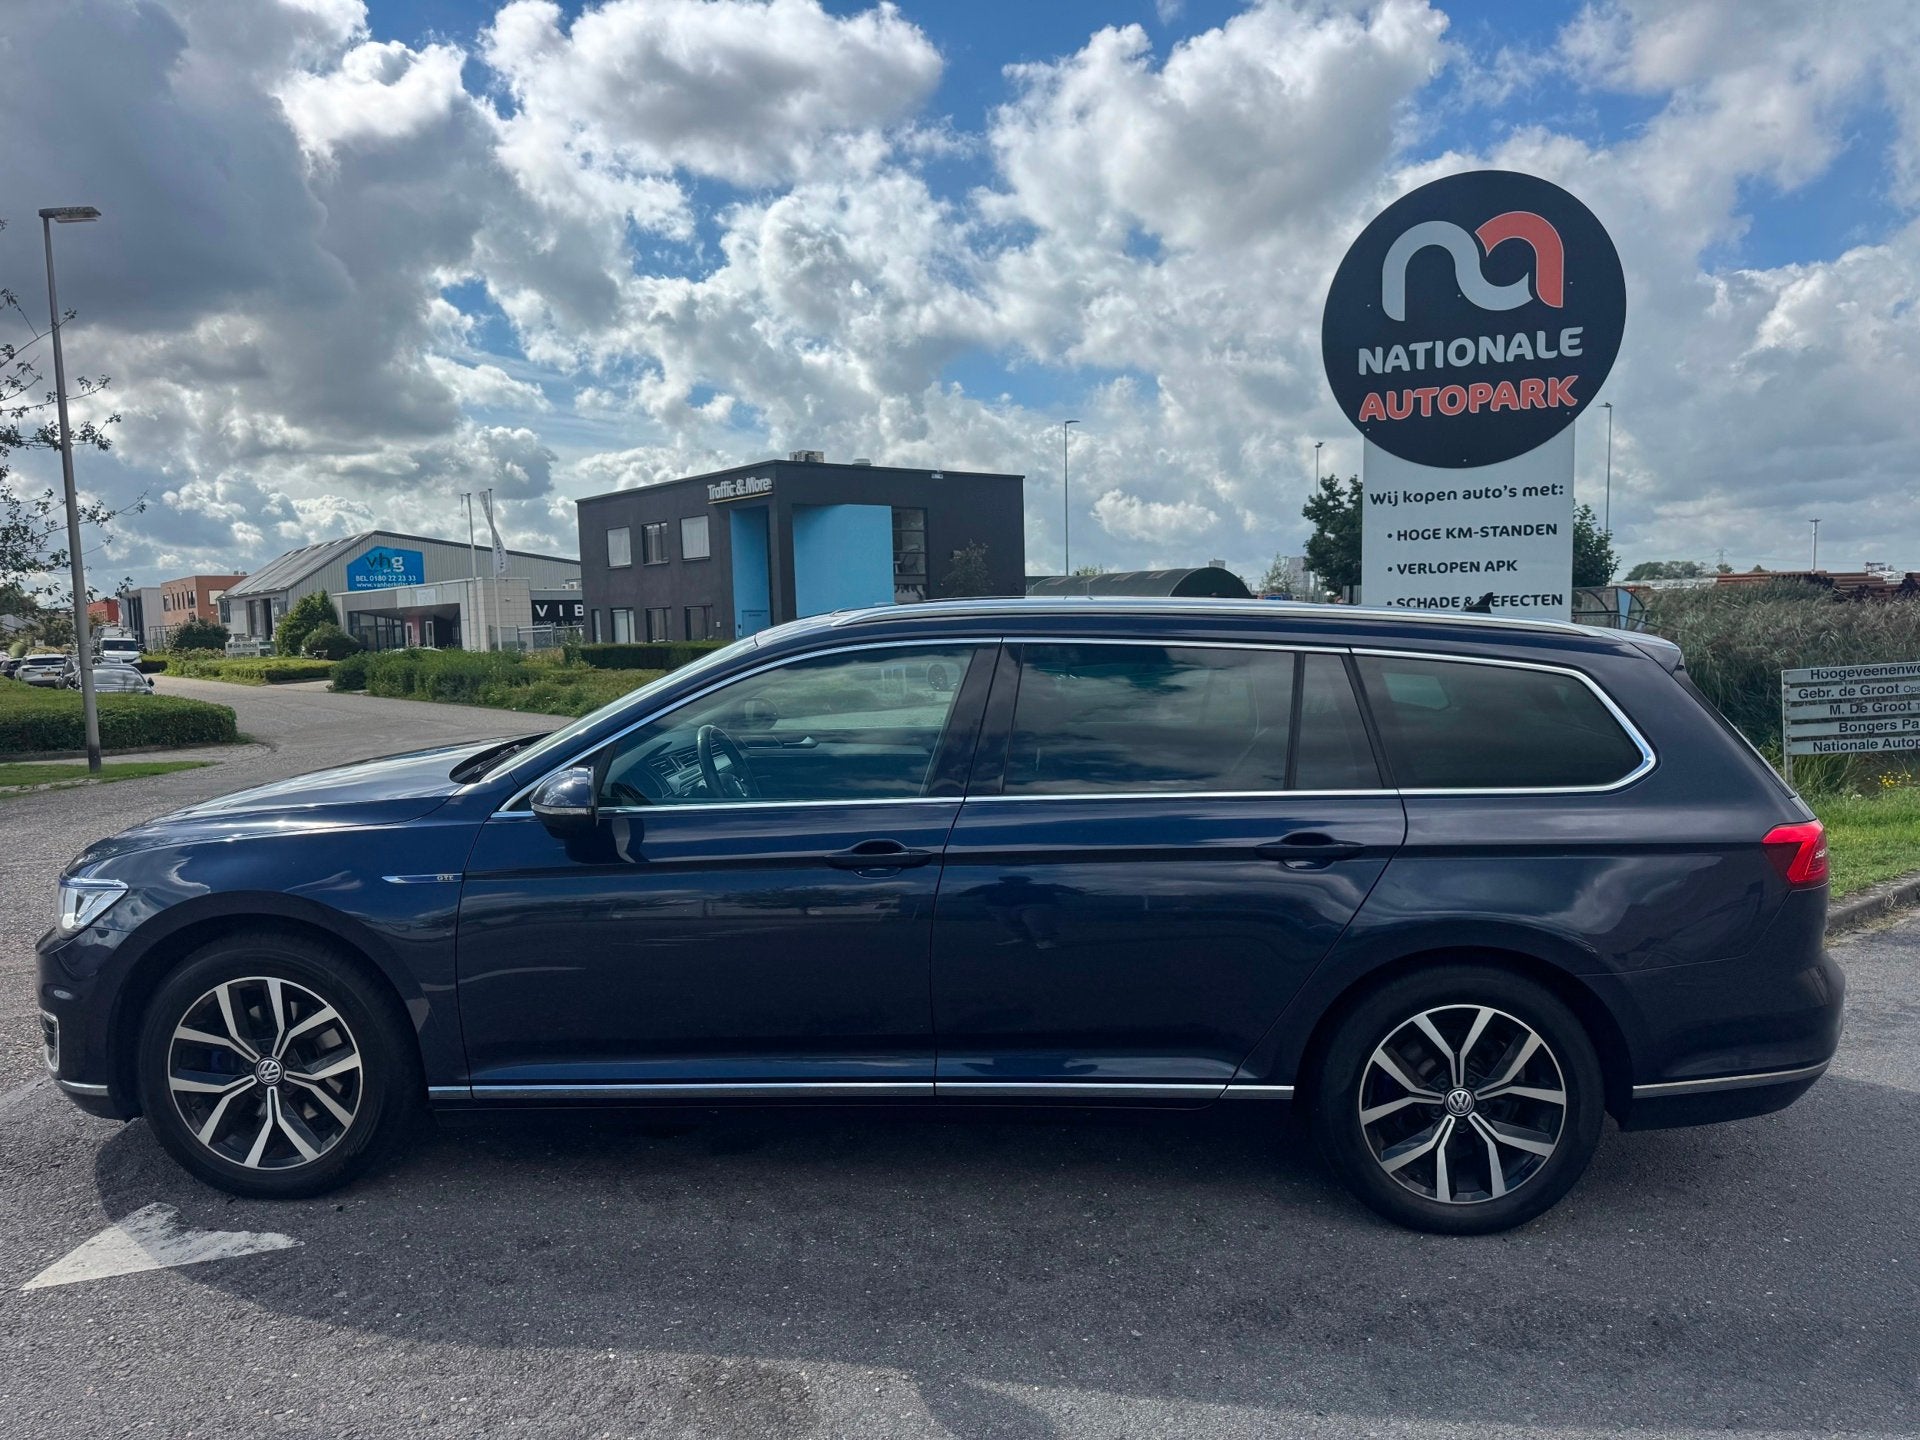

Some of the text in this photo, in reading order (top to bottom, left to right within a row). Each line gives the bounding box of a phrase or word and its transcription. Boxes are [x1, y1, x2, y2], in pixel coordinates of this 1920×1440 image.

[1358, 326, 1584, 375] NATIONALE
[1358, 375, 1579, 422] AUTOPARK
[707, 480, 736, 500] Traffic
[746, 476, 773, 493] More
[1369, 482, 1564, 507] Wij kopen auto's met:
[1396, 523, 1558, 542] HOGE KM-STANDEN
[365, 552, 405, 572] vhg
[1396, 559, 1519, 575] VERLOPEN APK
[1396, 596, 1460, 609] SCHADE
[1479, 593, 1563, 607] EFECTEN
[1798, 688, 1834, 699] Gebr.
[1839, 686, 1856, 697] de
[1860, 684, 1899, 696] Groot
[1829, 704, 1845, 715] M.
[1850, 704, 1868, 714] De
[1872, 702, 1912, 713] Groot
[1839, 720, 1897, 734] Bongers
[1813, 739, 1878, 752] Nationale
